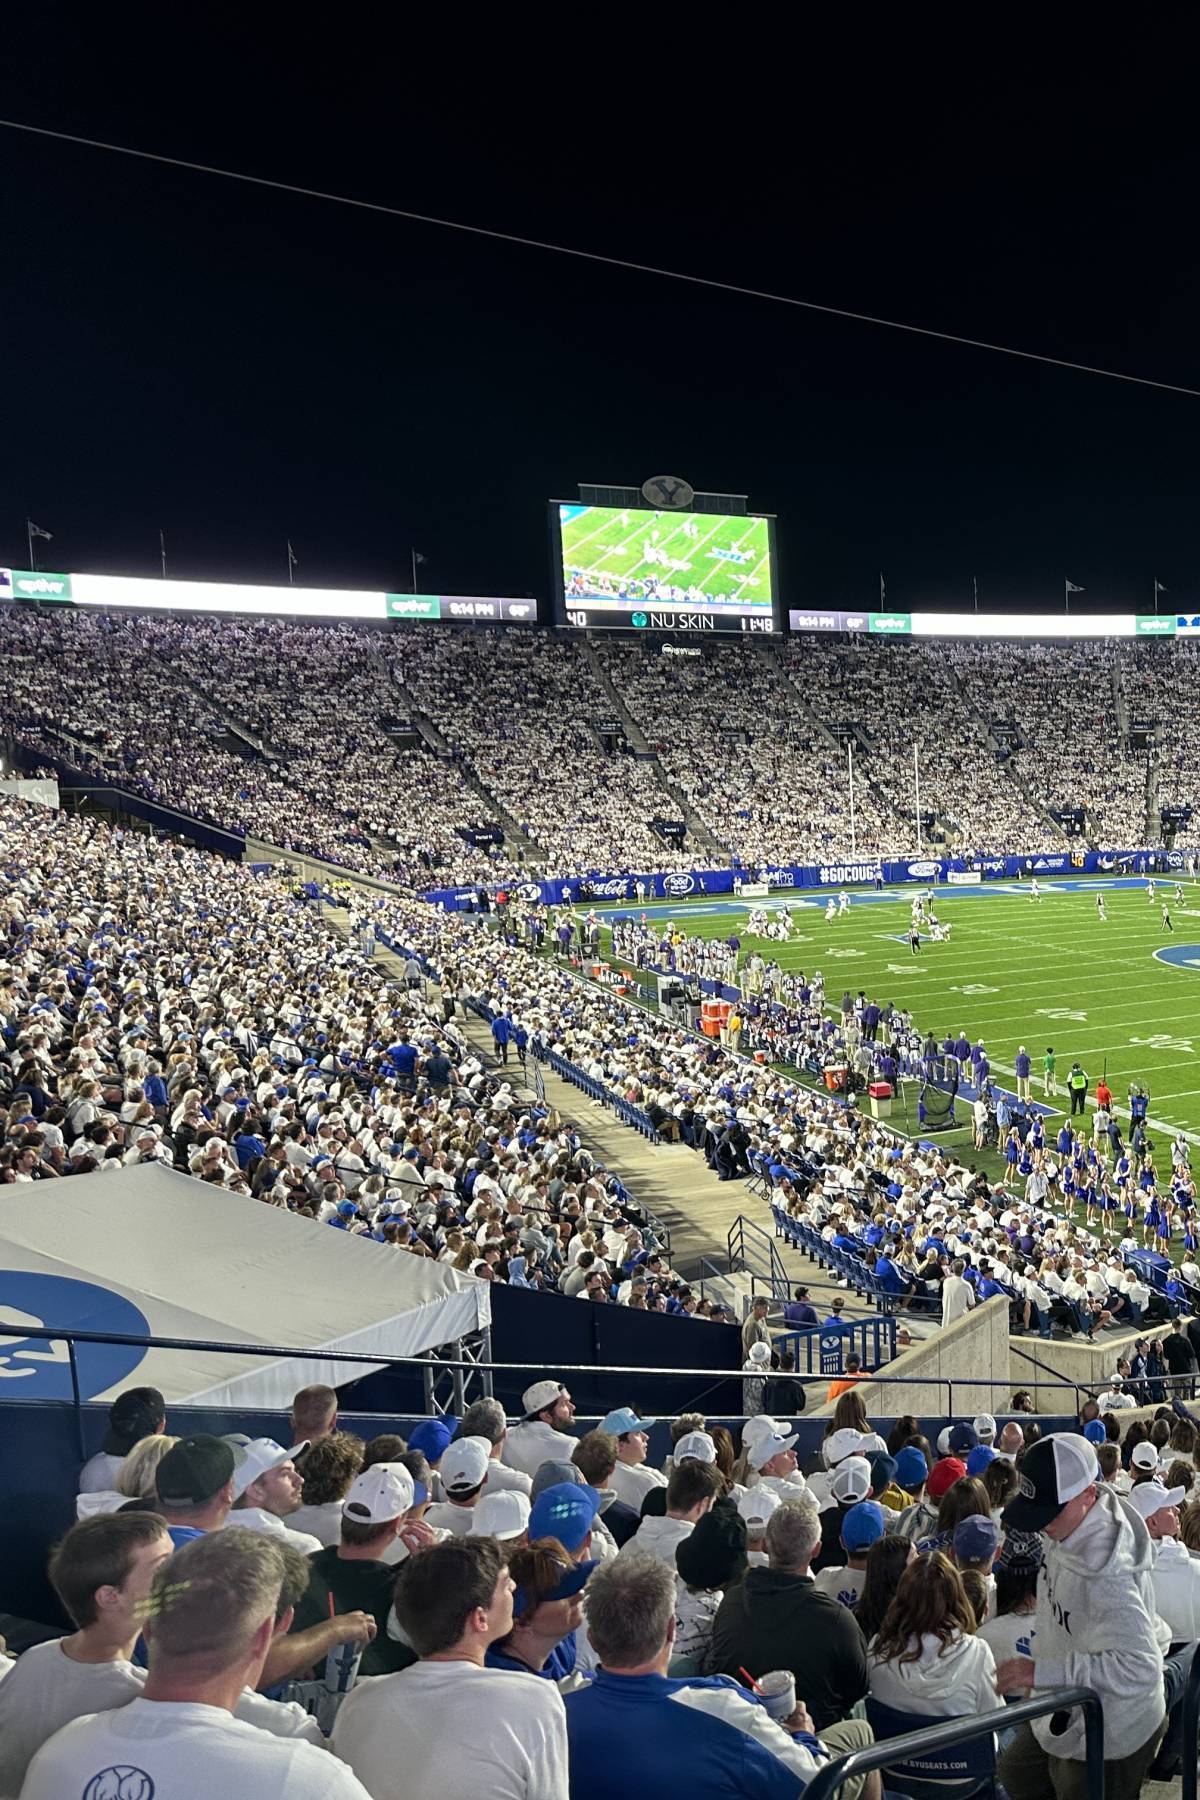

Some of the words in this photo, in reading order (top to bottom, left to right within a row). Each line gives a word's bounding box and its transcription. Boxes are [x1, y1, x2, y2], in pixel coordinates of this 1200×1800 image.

[650, 612, 675, 628] NU
[678, 613, 714, 630] SKIN
[740, 617, 773, 632] 11:48
[819, 617, 835, 628] PM
[1071, 857, 1085, 867] 40
